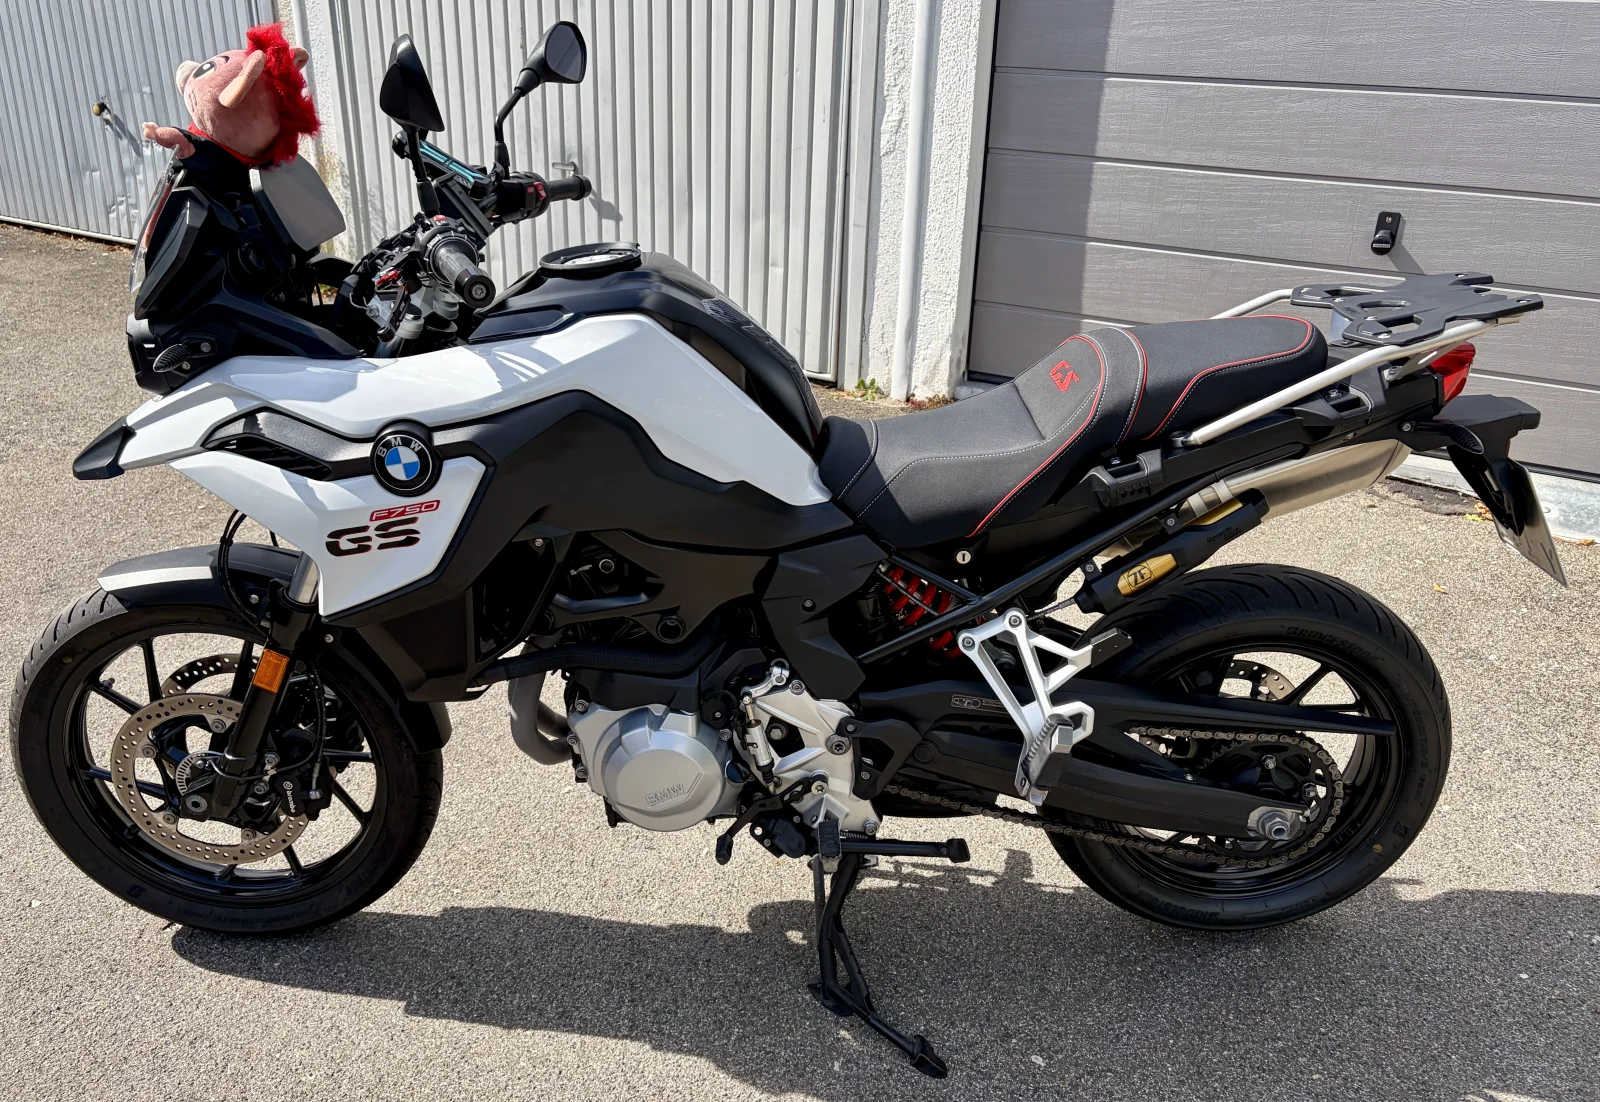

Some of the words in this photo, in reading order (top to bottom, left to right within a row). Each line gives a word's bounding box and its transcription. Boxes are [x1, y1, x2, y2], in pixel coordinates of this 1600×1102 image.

[1049, 360, 1080, 392] GS
[377, 437, 422, 457] BMW
[372, 501, 438, 521] F750
[325, 516, 421, 557] GS
[645, 783, 685, 807] BMW
